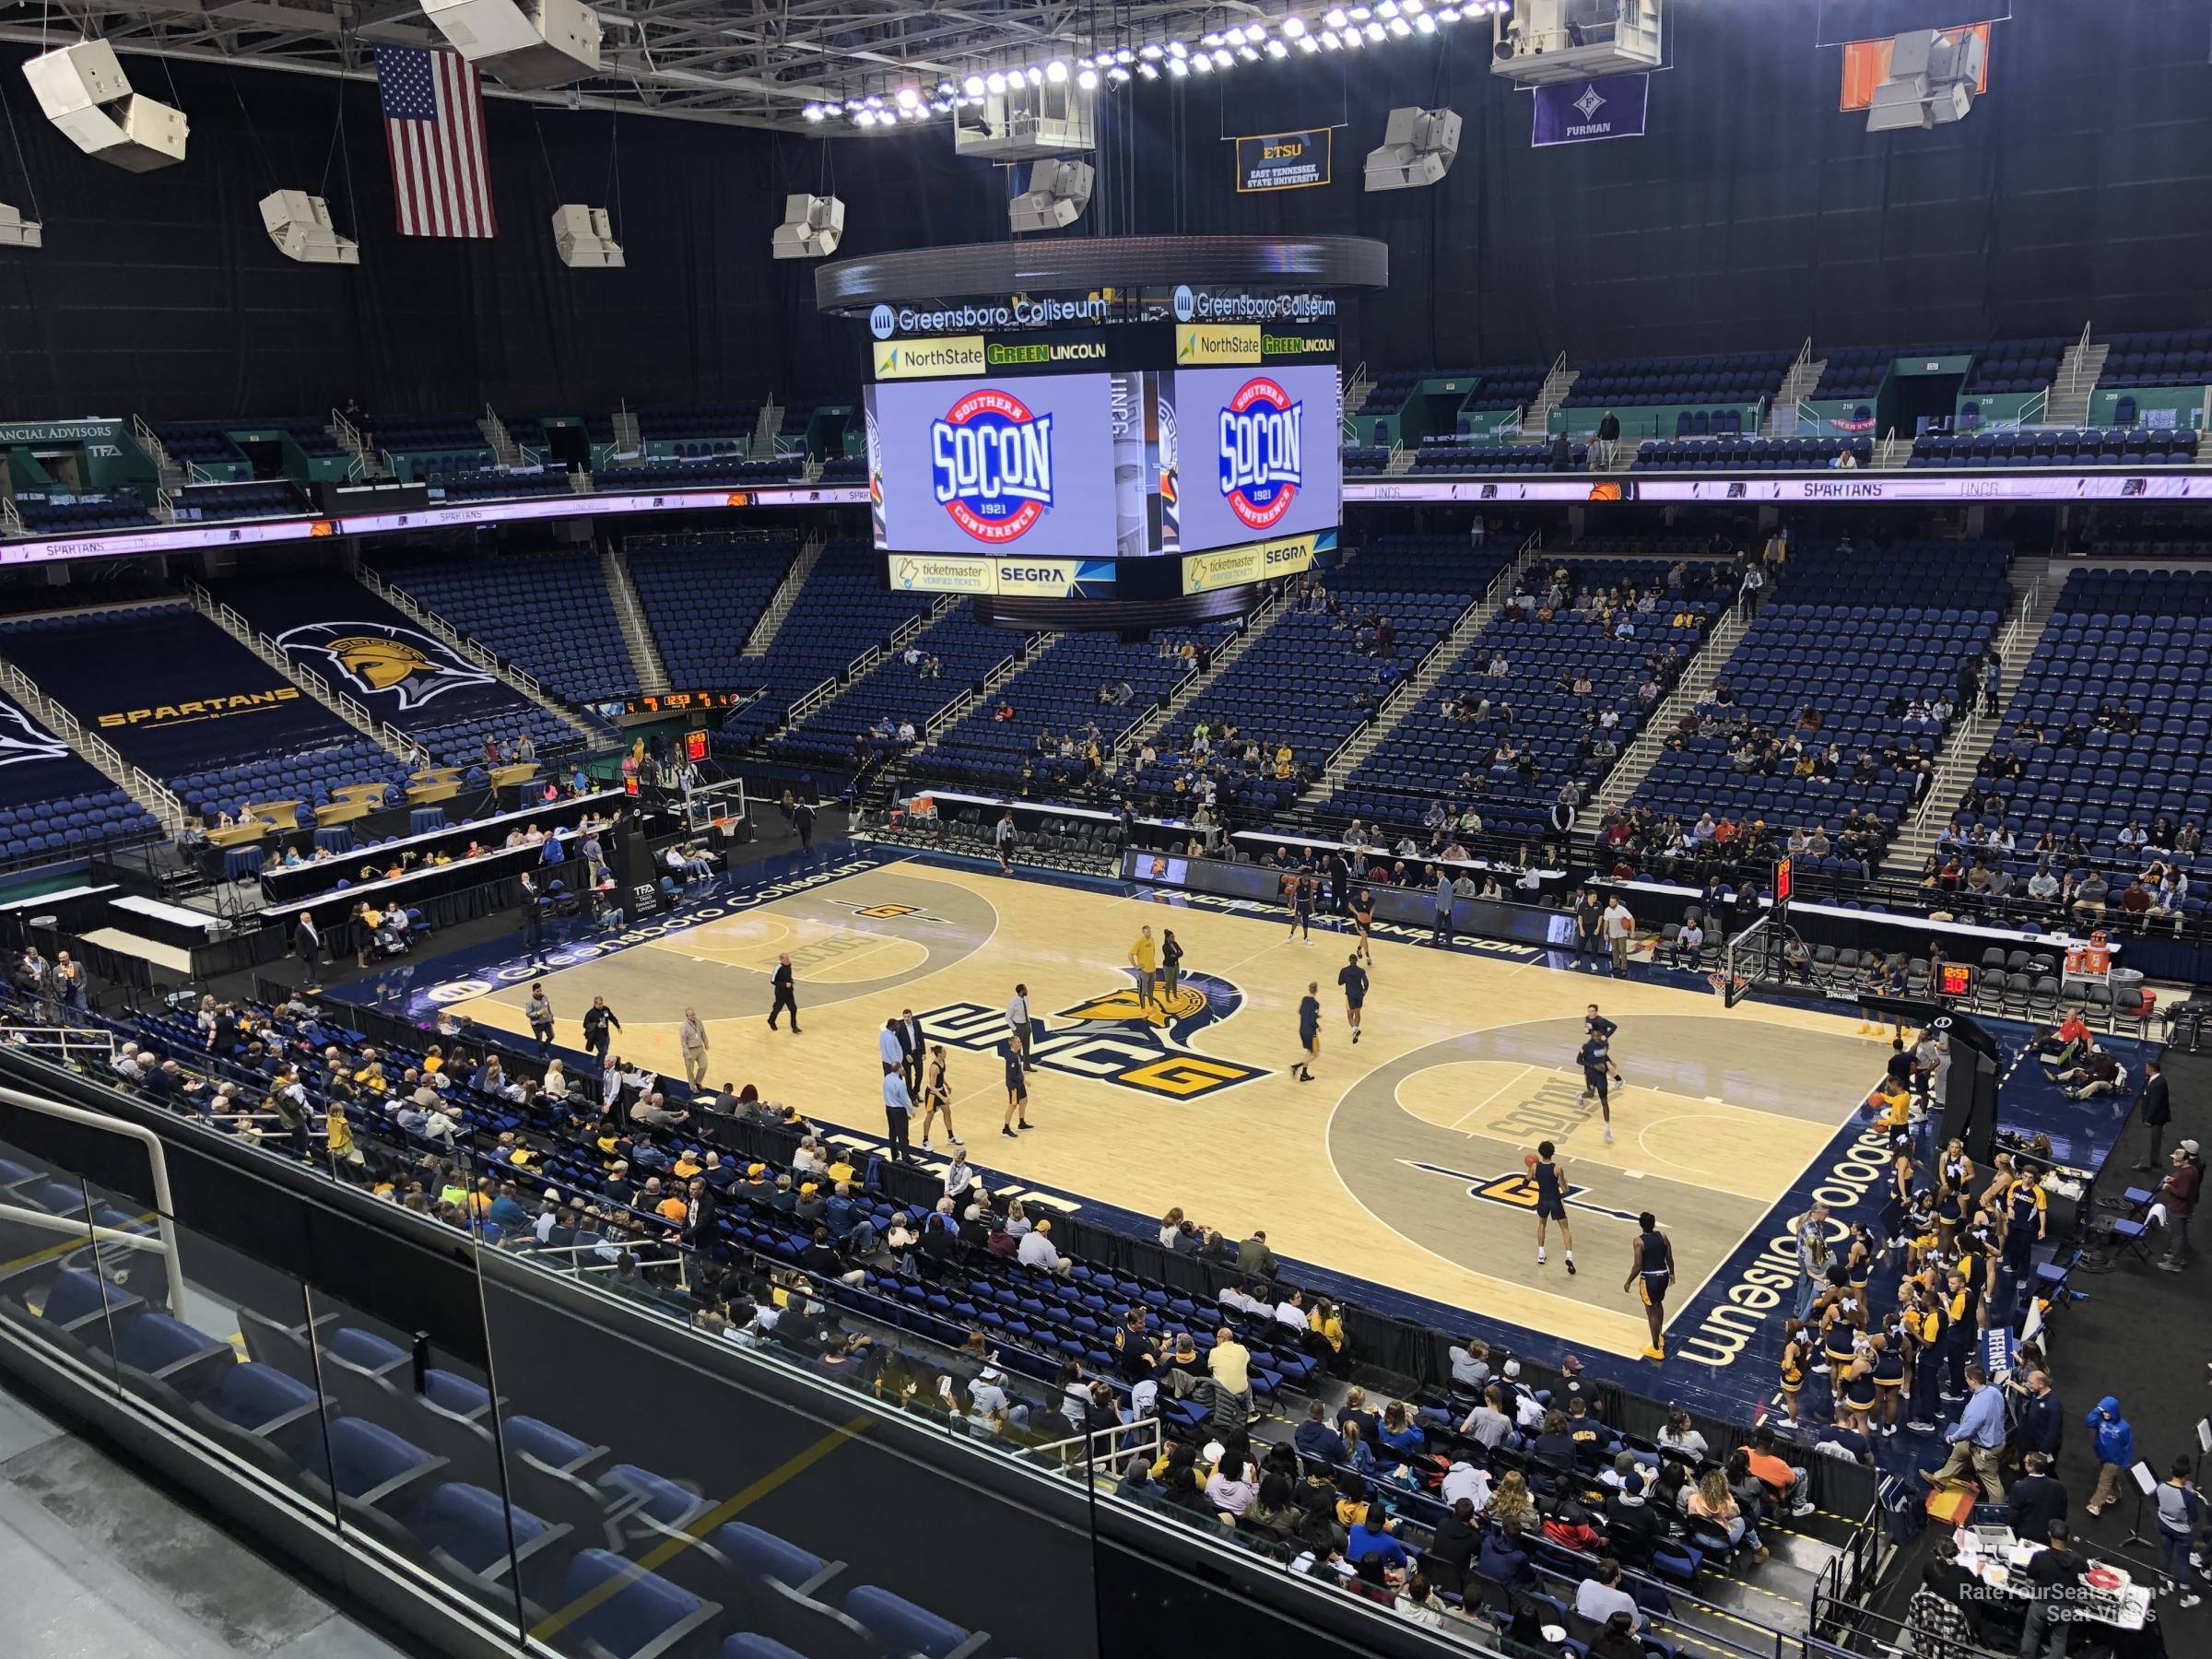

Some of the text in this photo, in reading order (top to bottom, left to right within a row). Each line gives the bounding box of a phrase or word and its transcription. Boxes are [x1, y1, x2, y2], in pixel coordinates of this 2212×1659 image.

[1566, 122, 1611, 136] FURMAN
[1263, 143, 1302, 159] ETSU
[1250, 164, 1316, 179] EAST TENNESSEE
[1247, 172, 1320, 188] STATE UNIVERSITY
[1198, 292, 1335, 316] Greensboro Coliseum
[899, 299, 1106, 331] Greensboro Coliseum
[1201, 336, 1259, 353] NorthState
[1262, 334, 1335, 354] GREEN LINCOLN
[904, 347, 982, 367] NorthState
[987, 343, 1106, 364] GREEN LINCOLN
[1237, 384, 1286, 410] SOUTHERN
[955, 395, 1024, 421] SOUTHERN
[47, 426, 112, 439] ADVISORS
[88, 445, 124, 457] TFA
[849, 490, 871, 500] SPAR
[1253, 489, 1271, 501] 1921
[1804, 482, 1883, 497] SPARTANS
[981, 504, 1006, 514] 1921
[1233, 488, 1290, 524] CONFERENCE
[953, 503, 1035, 538] CONFERENCE
[1266, 545, 1307, 564] SEGRA
[923, 563, 983, 578] ticketmaster
[1209, 555, 1255, 572] ticketmaster
[923, 577, 982, 587] VERIFIED TICKETS
[1001, 567, 1065, 582] SEGRA
[98, 687, 300, 727] SPARTANS
[633, 884, 655, 896] TFA
[498, 859, 881, 982] Greensboro Coliseum
[1944, 967, 1969, 979] 12:53
[1946, 979, 1964, 992] 30
[1826, 990, 1858, 1002] SPALDING
[1988, 1328, 2006, 1371] DEFENSE
